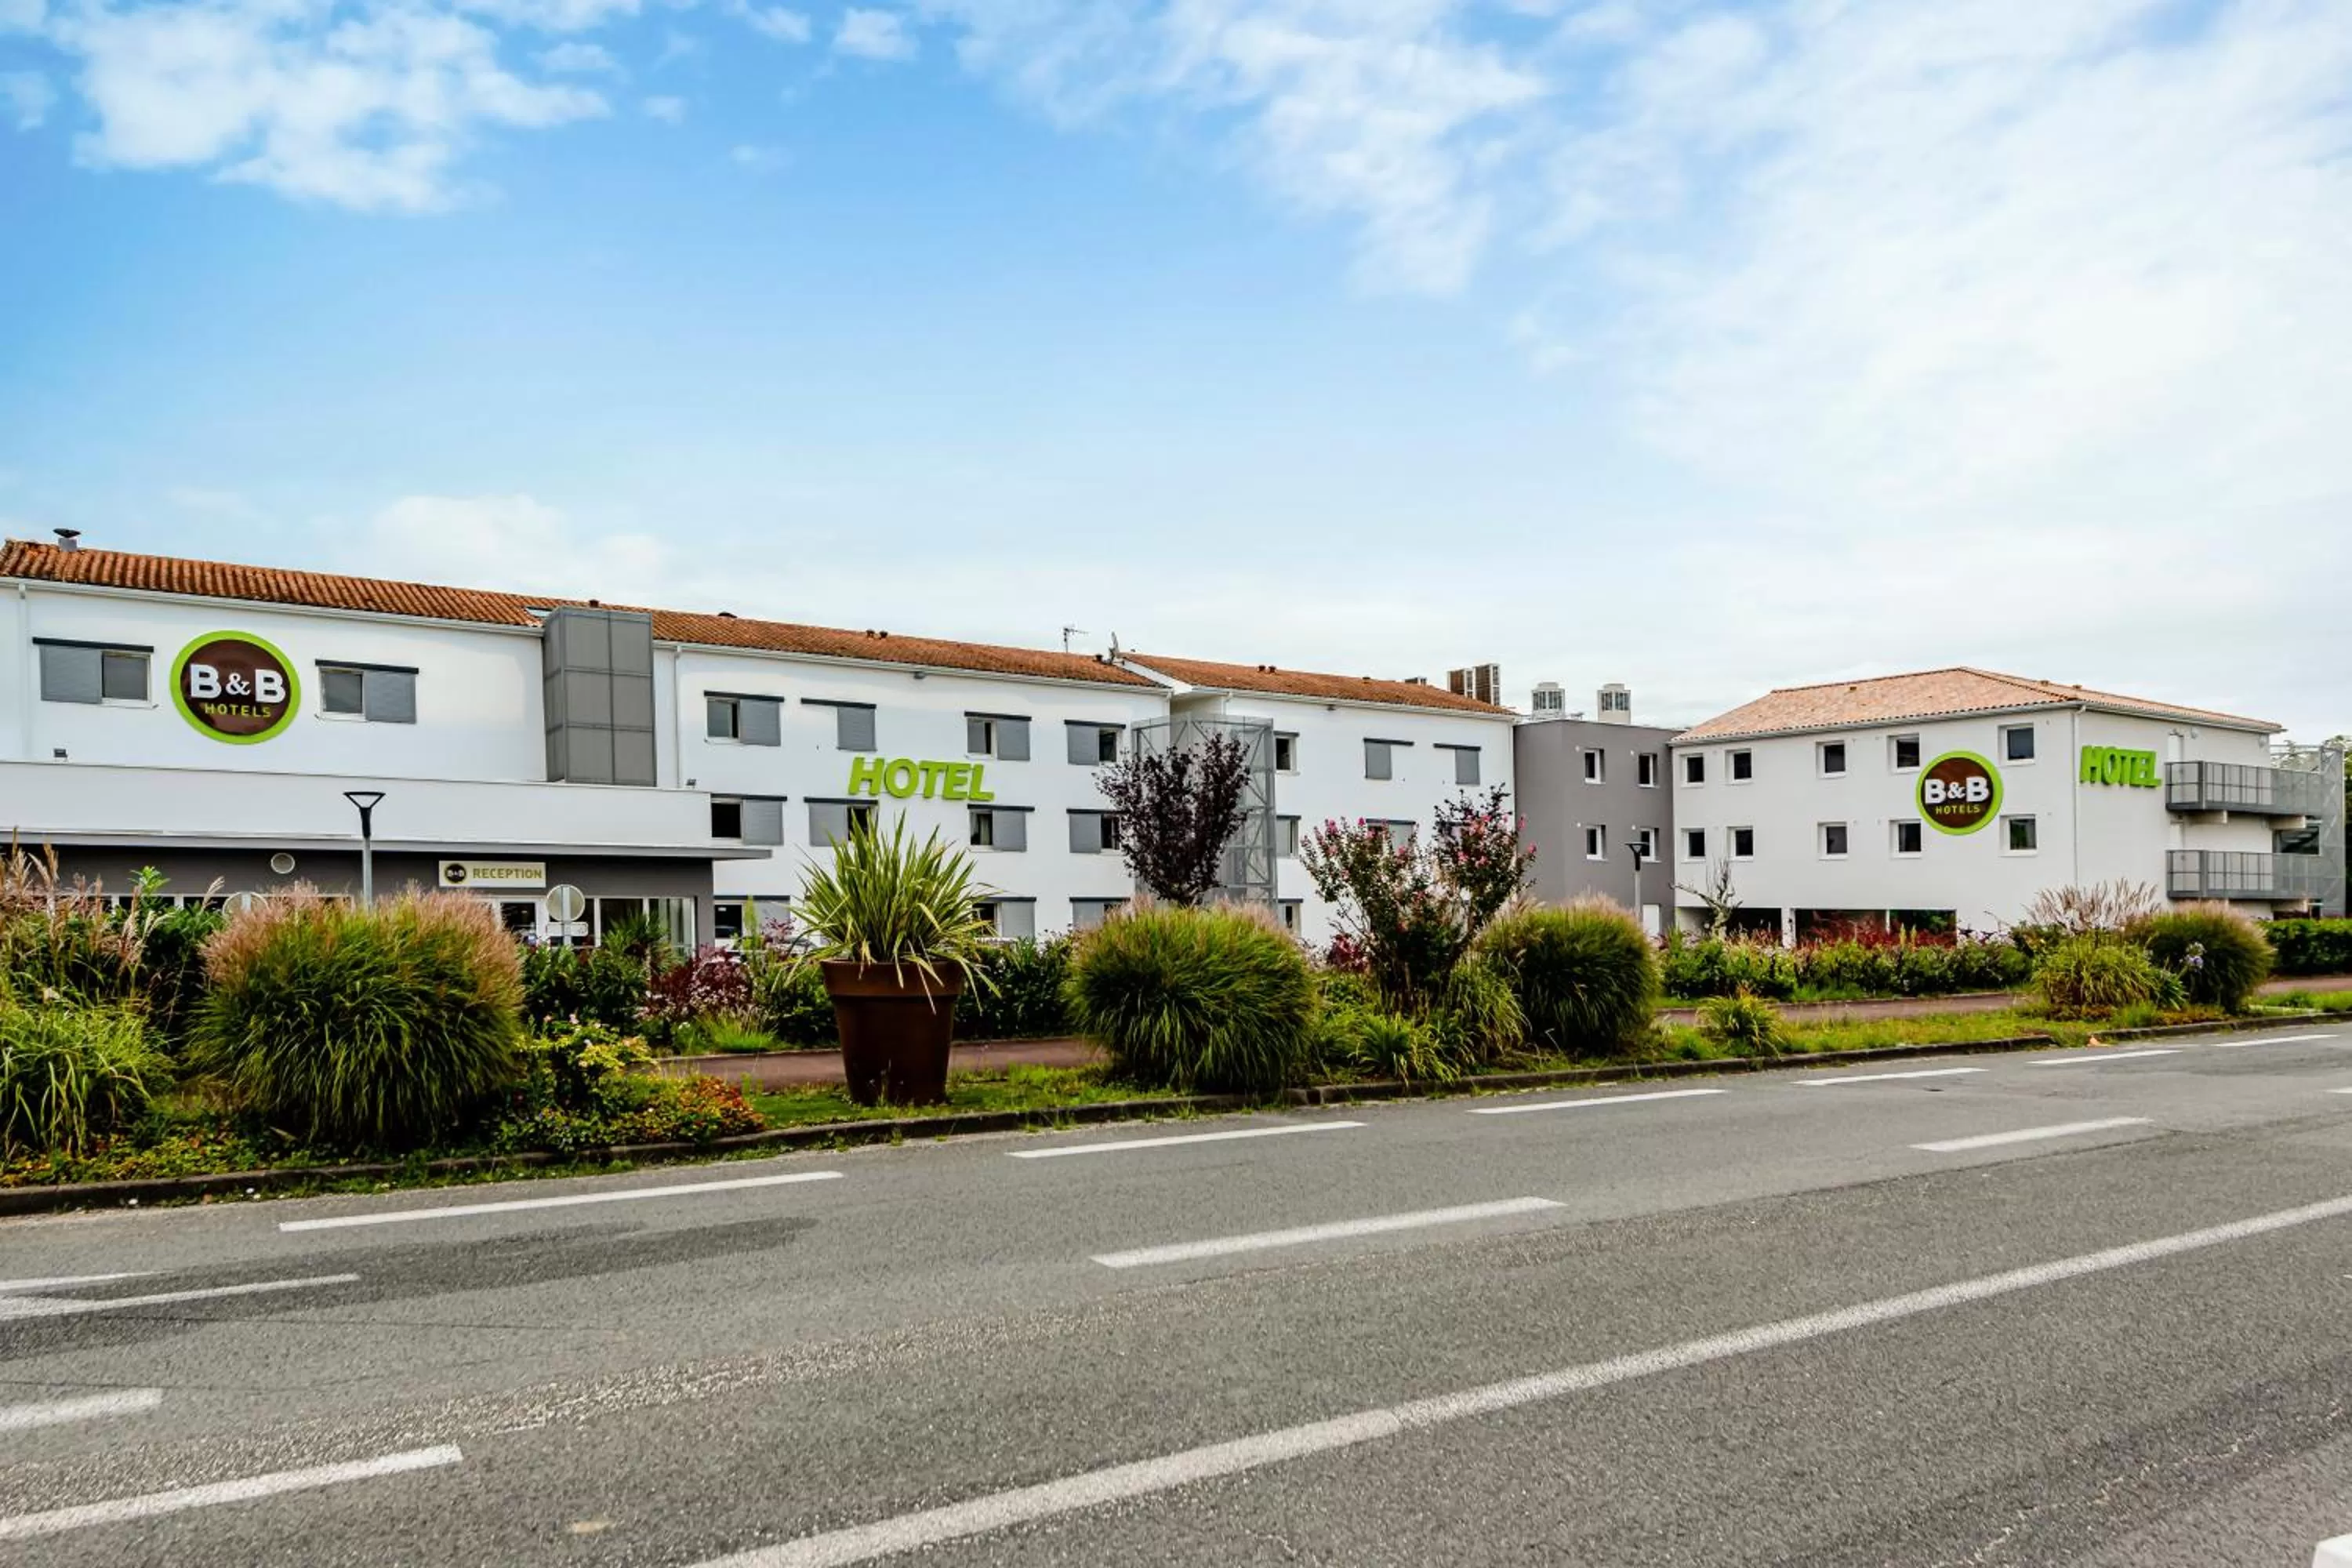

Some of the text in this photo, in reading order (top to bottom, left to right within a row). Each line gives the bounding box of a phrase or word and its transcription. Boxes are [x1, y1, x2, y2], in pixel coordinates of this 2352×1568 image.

[191, 663, 286, 703] B&B
[205, 702, 271, 718] HOTELS
[848, 756, 995, 801] HOTEL
[2079, 745, 2162, 788] HOTEL
[1925, 775, 1990, 804] B&B
[1935, 804, 1981, 815] HOTELS
[472, 867, 543, 880] RECEPTION
